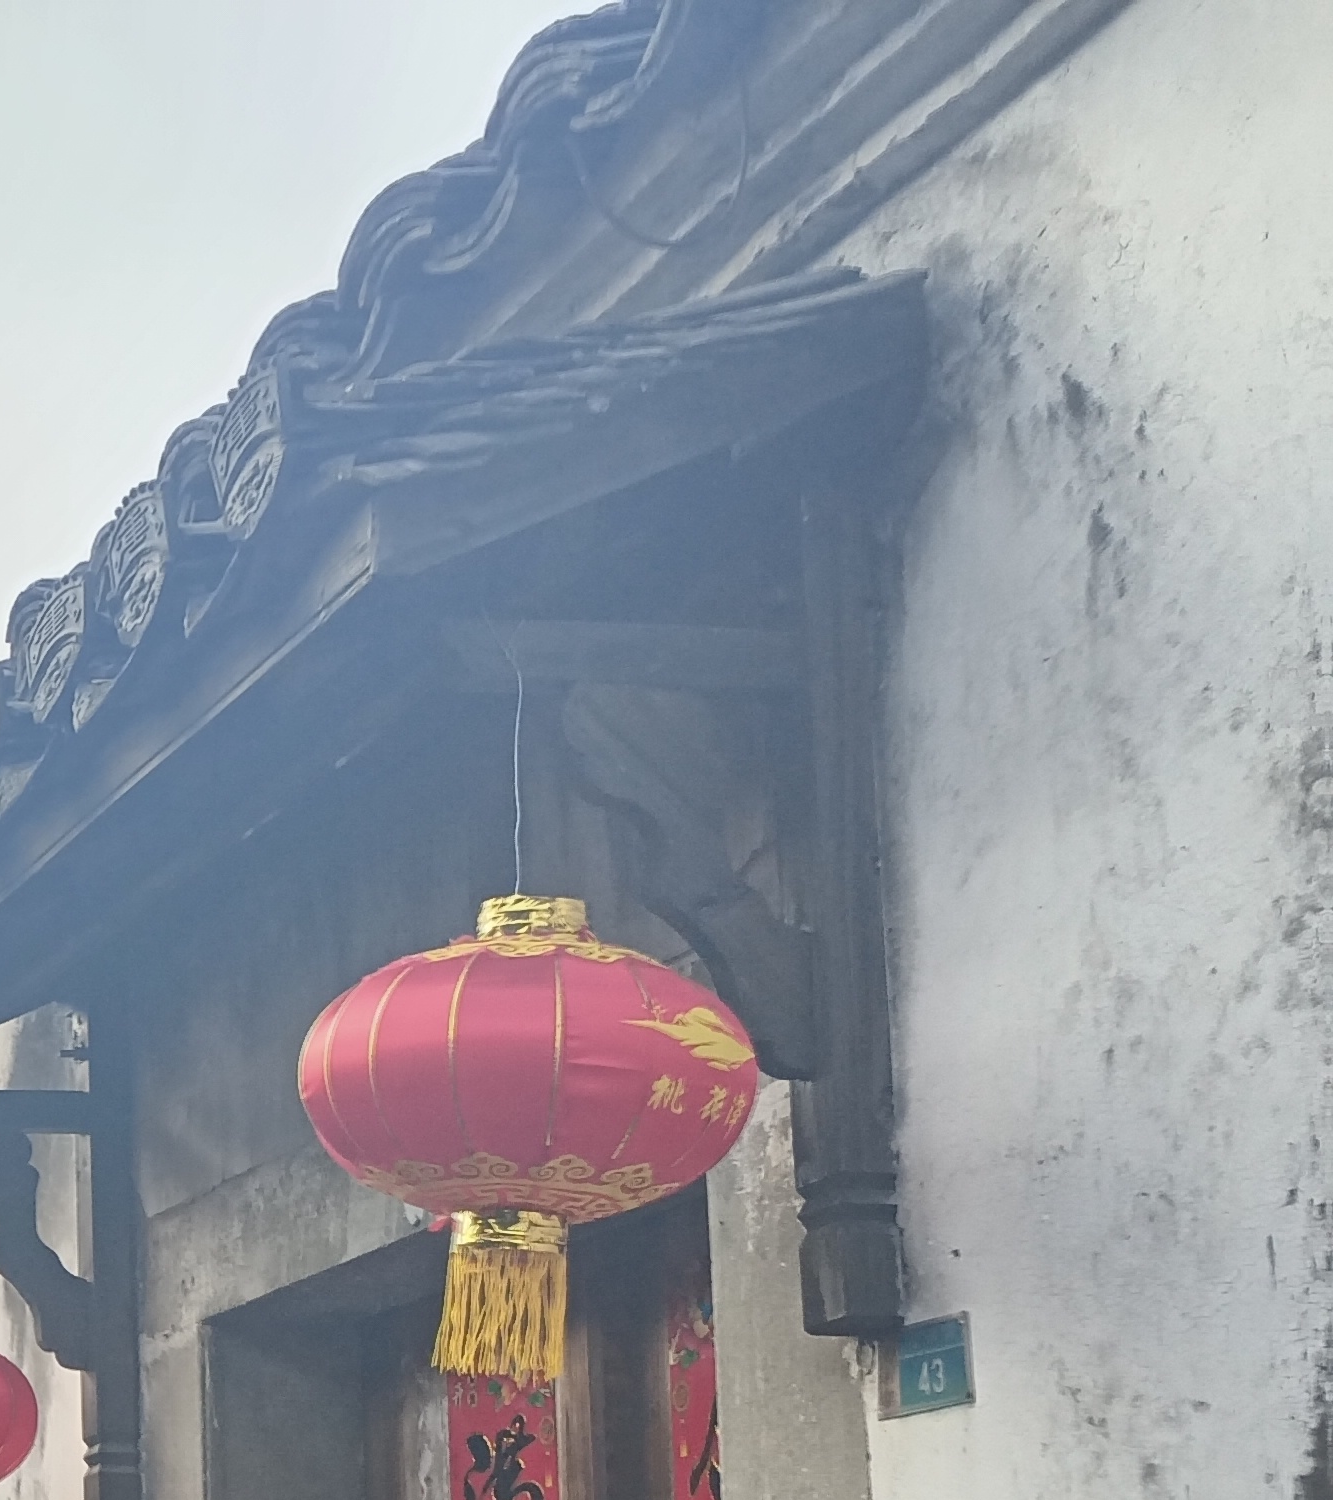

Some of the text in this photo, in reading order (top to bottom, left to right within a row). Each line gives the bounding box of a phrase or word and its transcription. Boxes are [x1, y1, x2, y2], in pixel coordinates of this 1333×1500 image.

[646, 1074, 748, 1138] 桃花潭
[919, 1357, 945, 1395] 43
